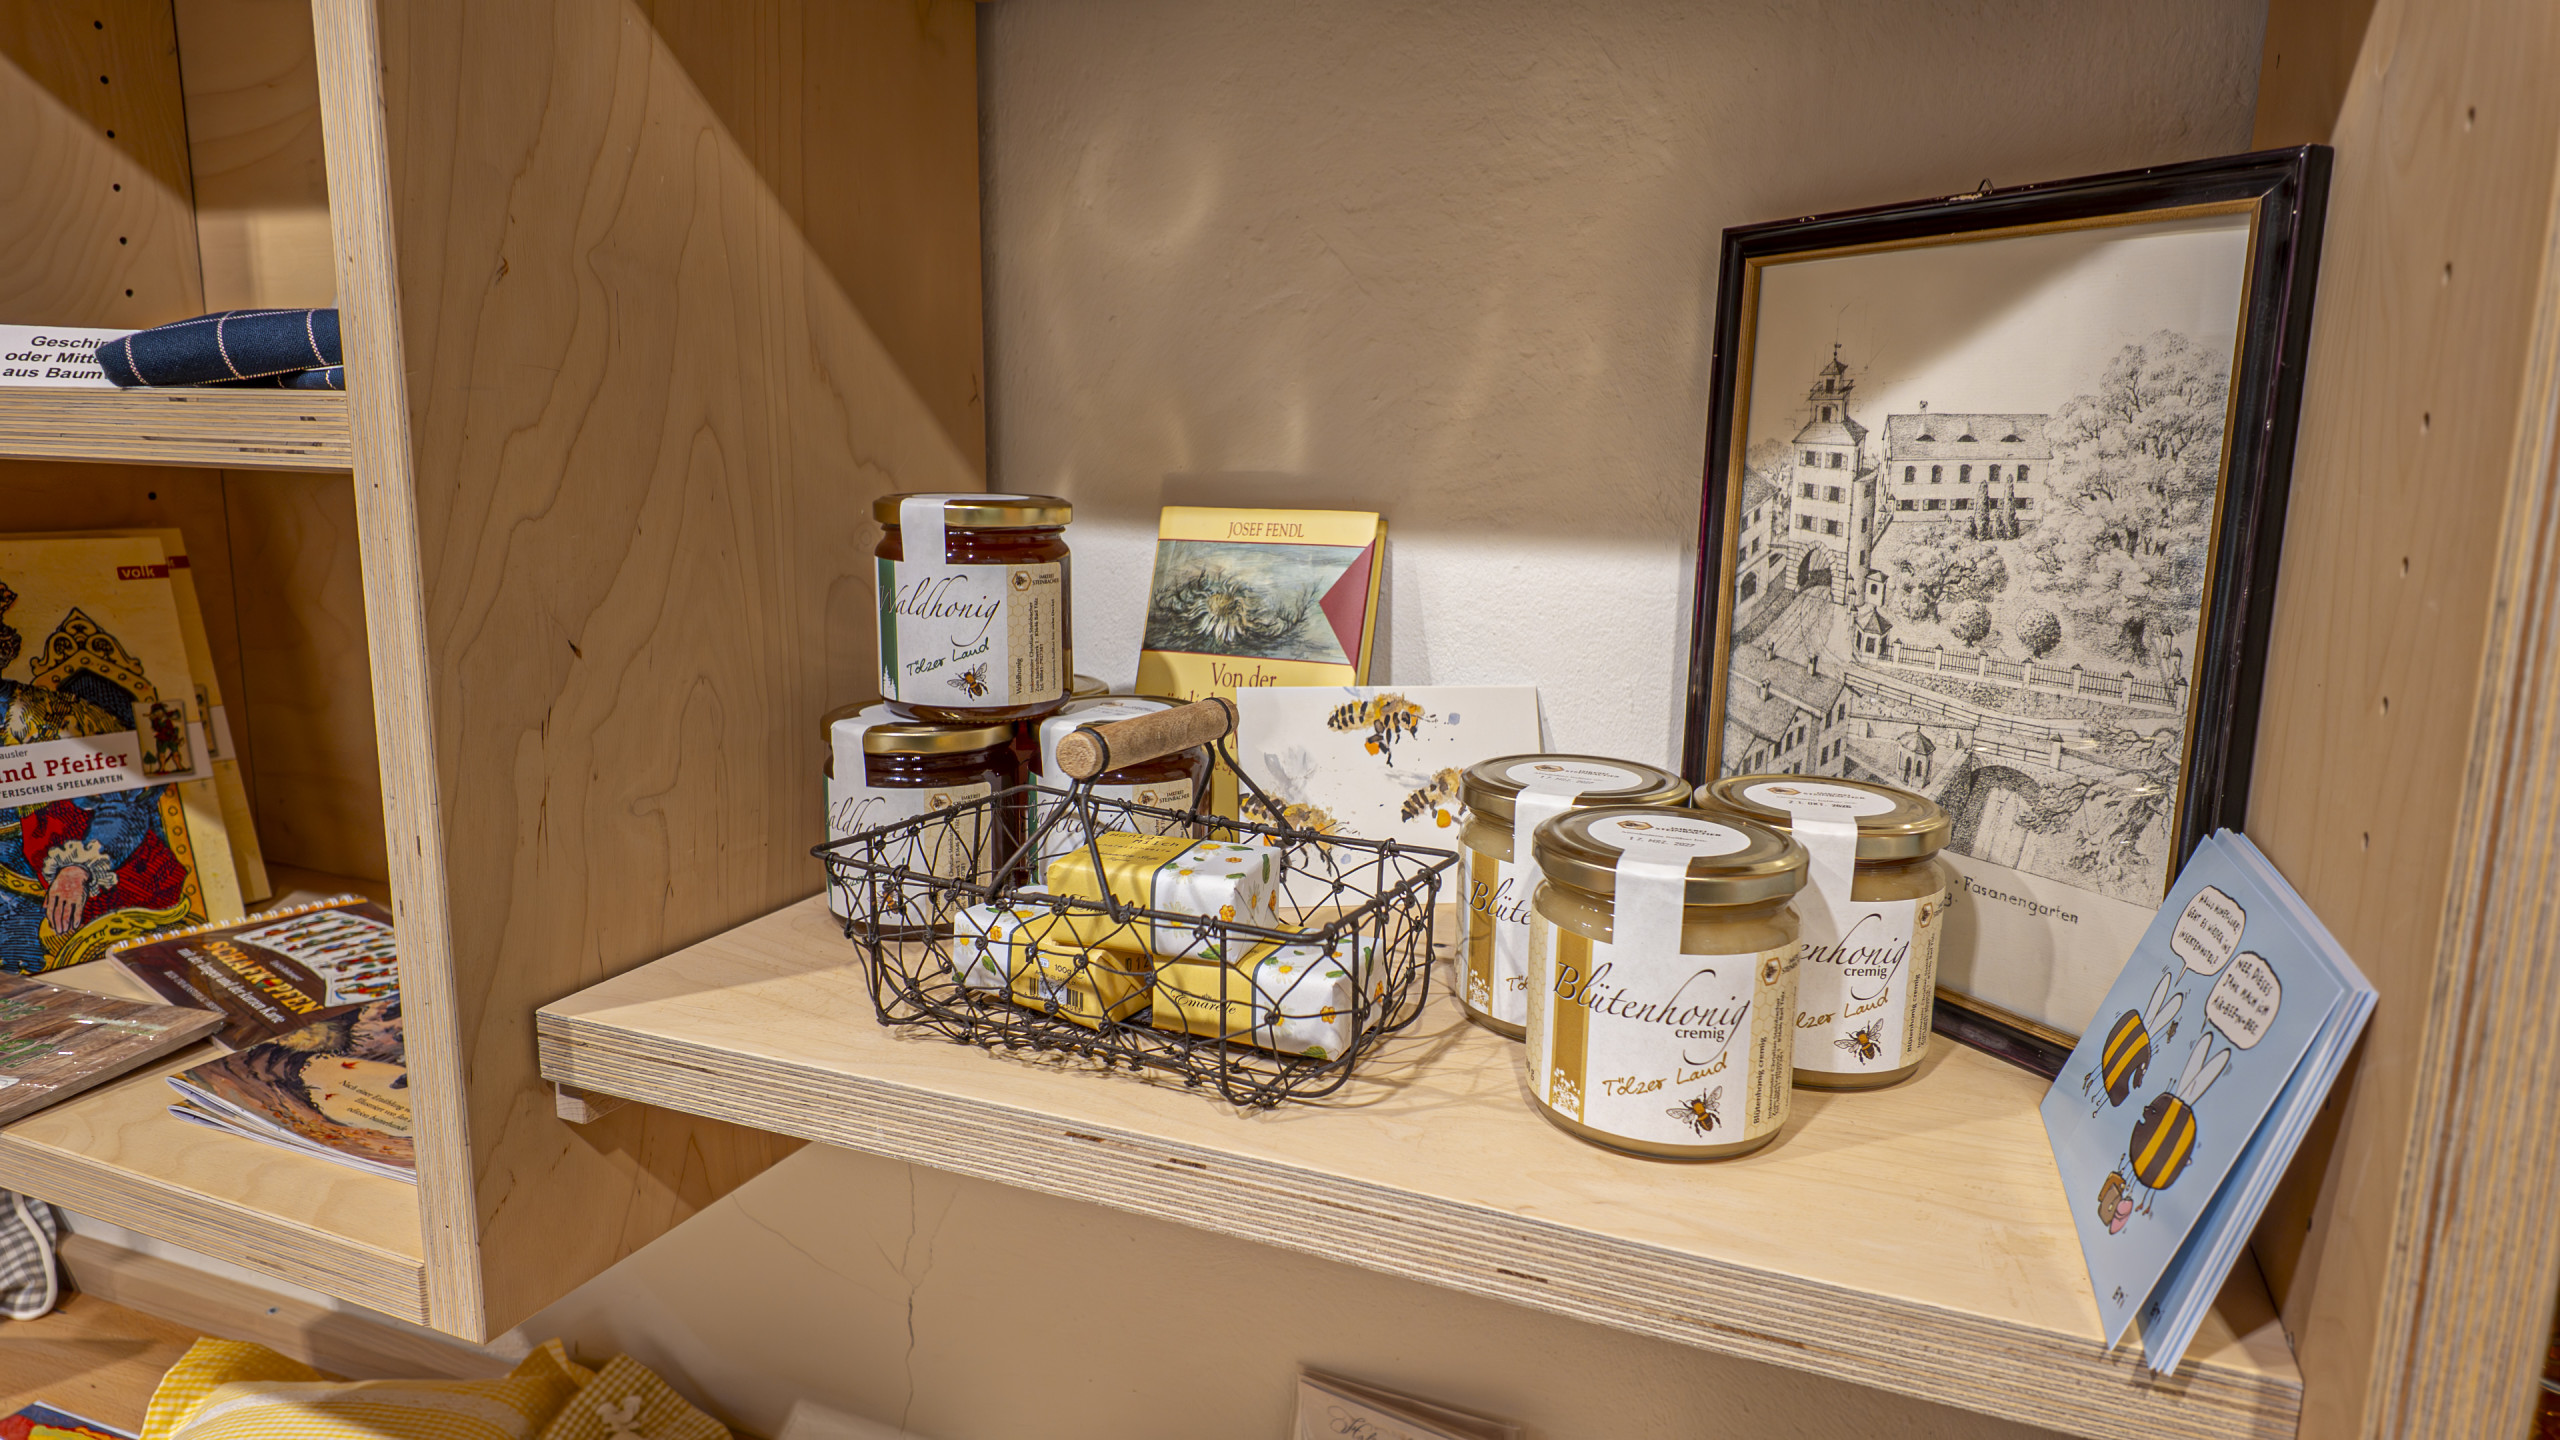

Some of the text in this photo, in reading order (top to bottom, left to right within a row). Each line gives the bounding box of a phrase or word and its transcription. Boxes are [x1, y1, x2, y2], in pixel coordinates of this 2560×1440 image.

[5, 351, 52, 362] oder
[3, 367, 104, 379] aus Baum
[1227, 522, 1304, 538] JOSEF FENDL
[121, 565, 155, 578] volk
[880, 574, 1000, 647] Waldhonig
[906, 636, 989, 676] Tölzer Land
[1212, 662, 1277, 687] Von der
[44, 752, 128, 777] Pfeifer
[0, 774, 123, 798] ERISCHEN SPIELKARTEN
[1470, 878, 1532, 925] Blüte
[1964, 876, 2079, 924] Fasanengarten
[2187, 906, 2202, 922] GEHT
[2200, 918, 2208, 930] ES
[1800, 913, 1910, 1000] enhonig
[1844, 965, 1887, 980] cremig
[260, 1006, 286, 1024] Karte
[1553, 962, 1750, 1066] Blütenhonig
[1796, 987, 1889, 1028] lzer Land
[1674, 1027, 1725, 1042] cremig
[1602, 1051, 1728, 1096] Tölzer Land
[1754, 1037, 1767, 1124] Blütenhonig cremig
